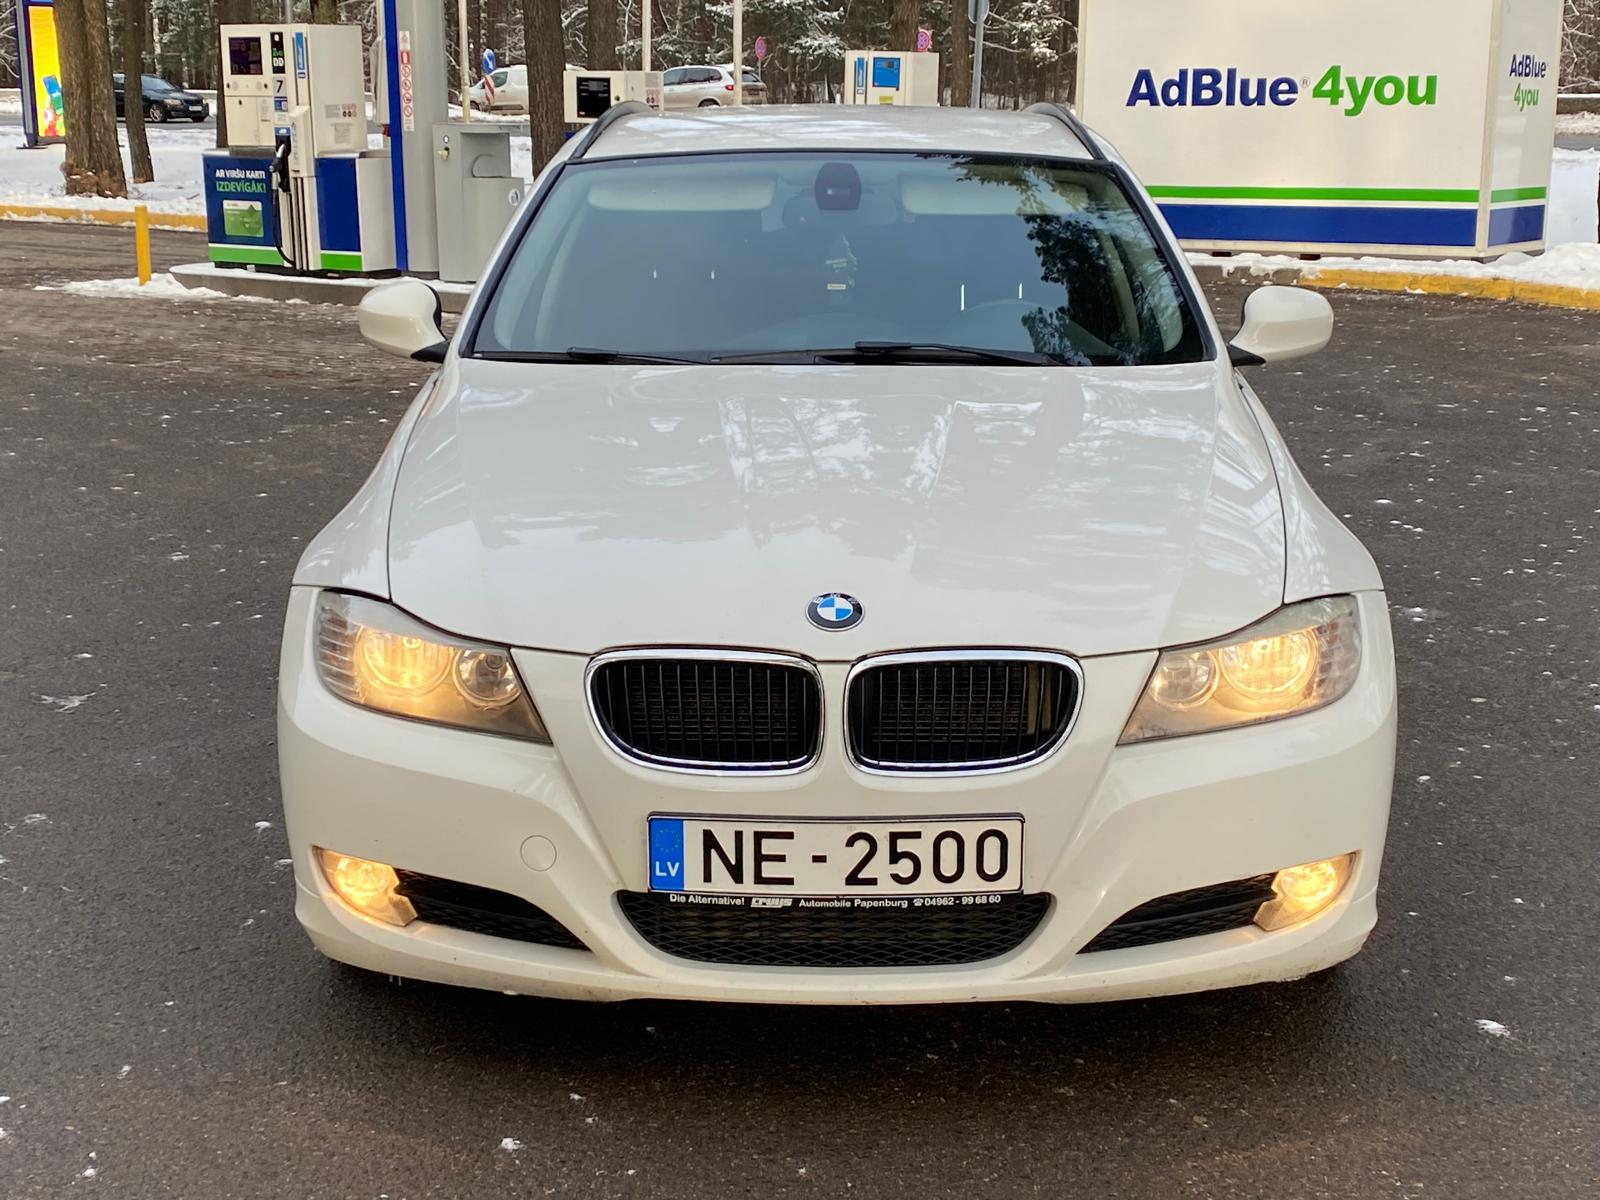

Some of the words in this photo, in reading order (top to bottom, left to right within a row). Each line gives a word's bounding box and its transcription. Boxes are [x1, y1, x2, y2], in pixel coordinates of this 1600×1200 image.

[1509, 54, 1547, 78] AdBlue
[276, 79, 283, 93] 7
[1312, 65, 1438, 117] 4you
[1513, 82, 1539, 112] 4you
[215, 169, 225, 178] AR
[245, 169, 266, 179] KARTI
[655, 861, 680, 877] LV
[669, 893, 687, 903] Die
[688, 894, 745, 906] Alternative!
[799, 899, 851, 908] Automobile
[854, 898, 908, 909] Papenburg
[924, 896, 954, 906] 04962
